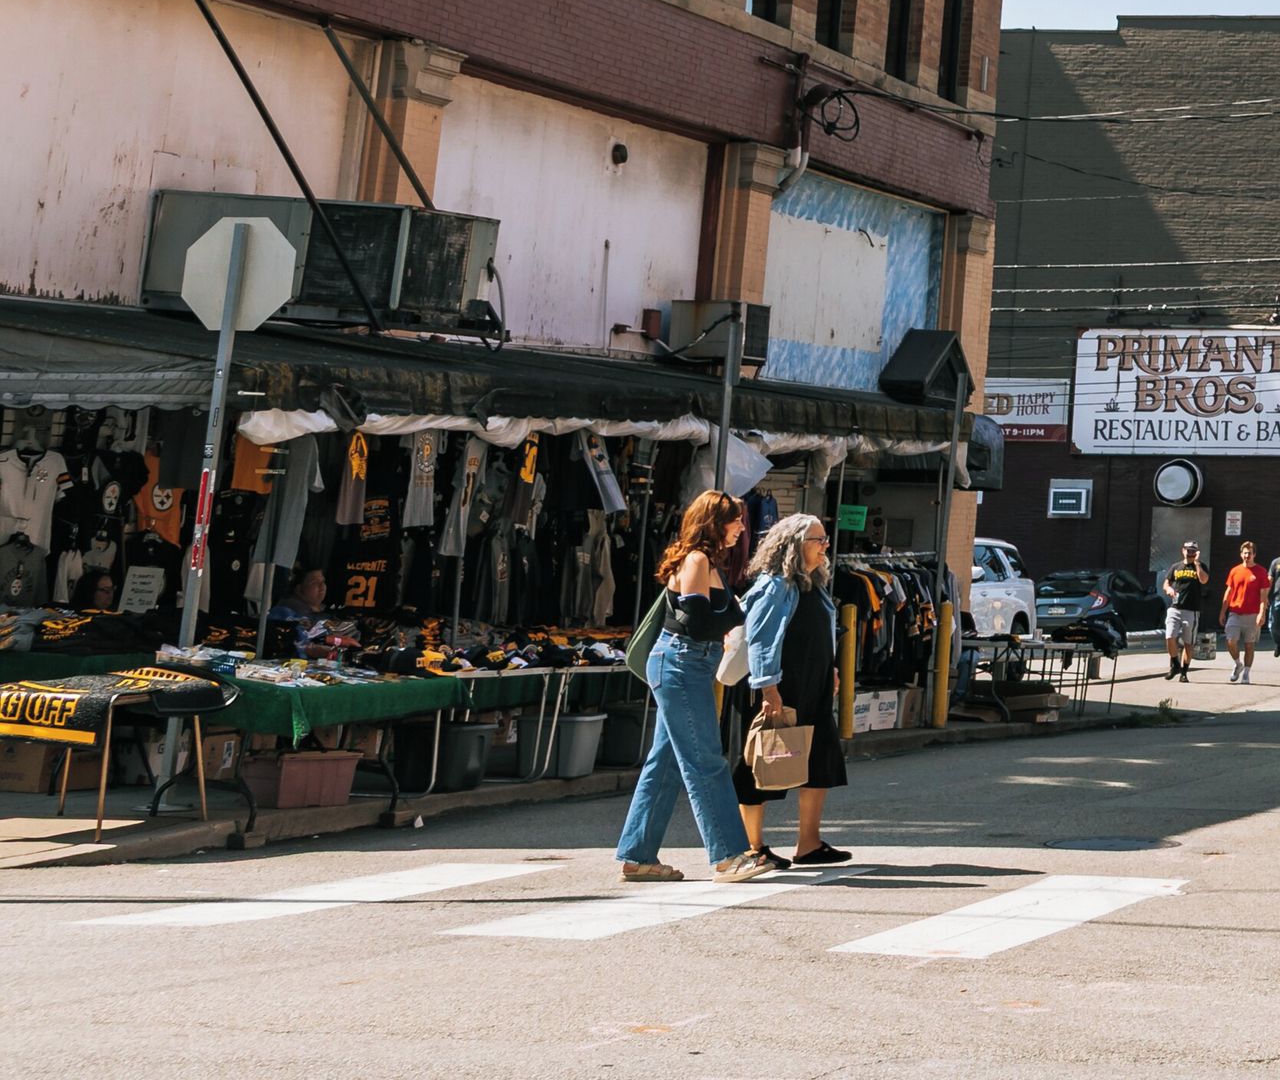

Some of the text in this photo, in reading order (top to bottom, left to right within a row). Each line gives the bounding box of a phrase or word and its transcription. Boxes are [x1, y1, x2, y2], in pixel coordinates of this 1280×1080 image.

[1017, 391, 1056, 405] HAPPY
[1133, 375, 1265, 418] BROS.
[1016, 405, 1051, 416] HOUR
[1012, 428, 1045, 436] 9-11PM
[1093, 418, 1232, 442] RESTAURANT
[1237, 422, 1250, 440] &
[345, 575, 378, 608] 21
[26, 693, 82, 726] OFF
